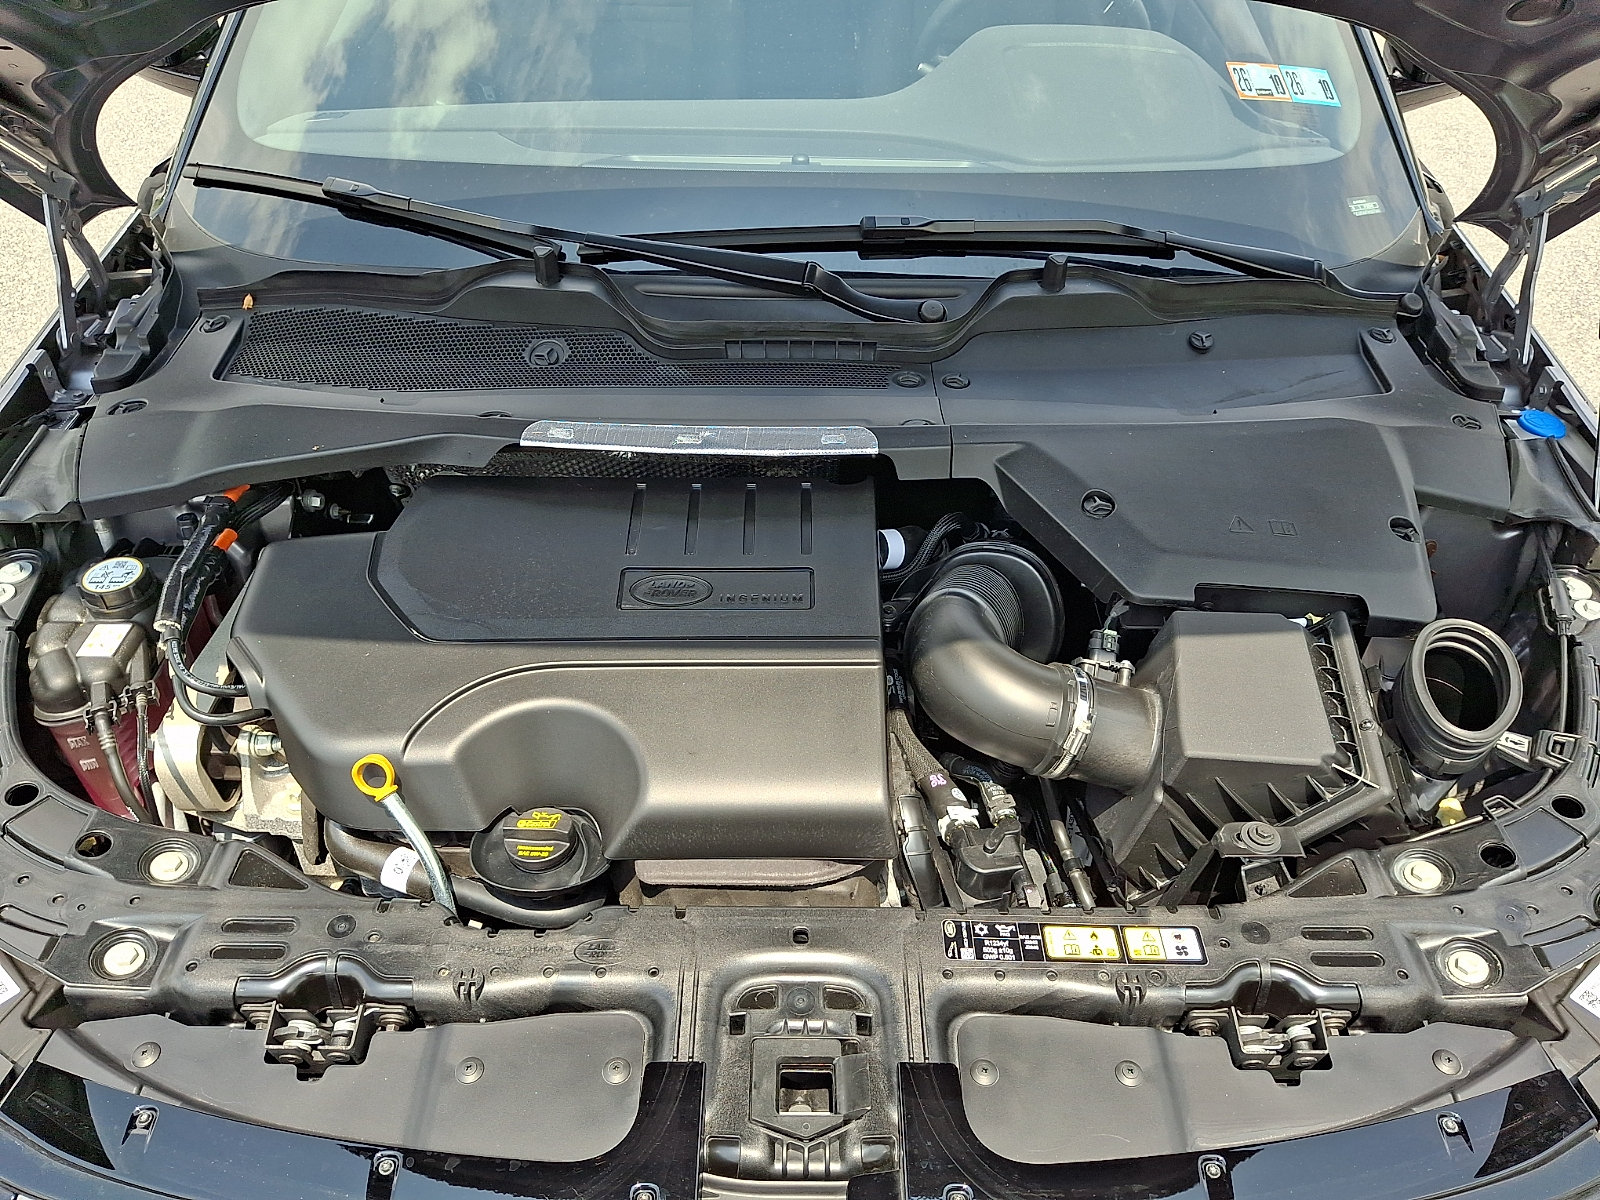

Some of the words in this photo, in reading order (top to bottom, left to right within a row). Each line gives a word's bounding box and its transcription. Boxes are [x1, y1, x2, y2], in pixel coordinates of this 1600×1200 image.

[1233, 67, 1253, 92] 26
[1269, 74, 1287, 95] 10
[1285, 70, 1305, 96] 26
[1318, 78, 1335, 100] 10
[651, 580, 688, 588] LAND
[651, 589, 698, 598] ROVER
[719, 593, 804, 603] INGENIUM
[67, 735, 90, 749] MAX
[79, 758, 99, 772] MIN
